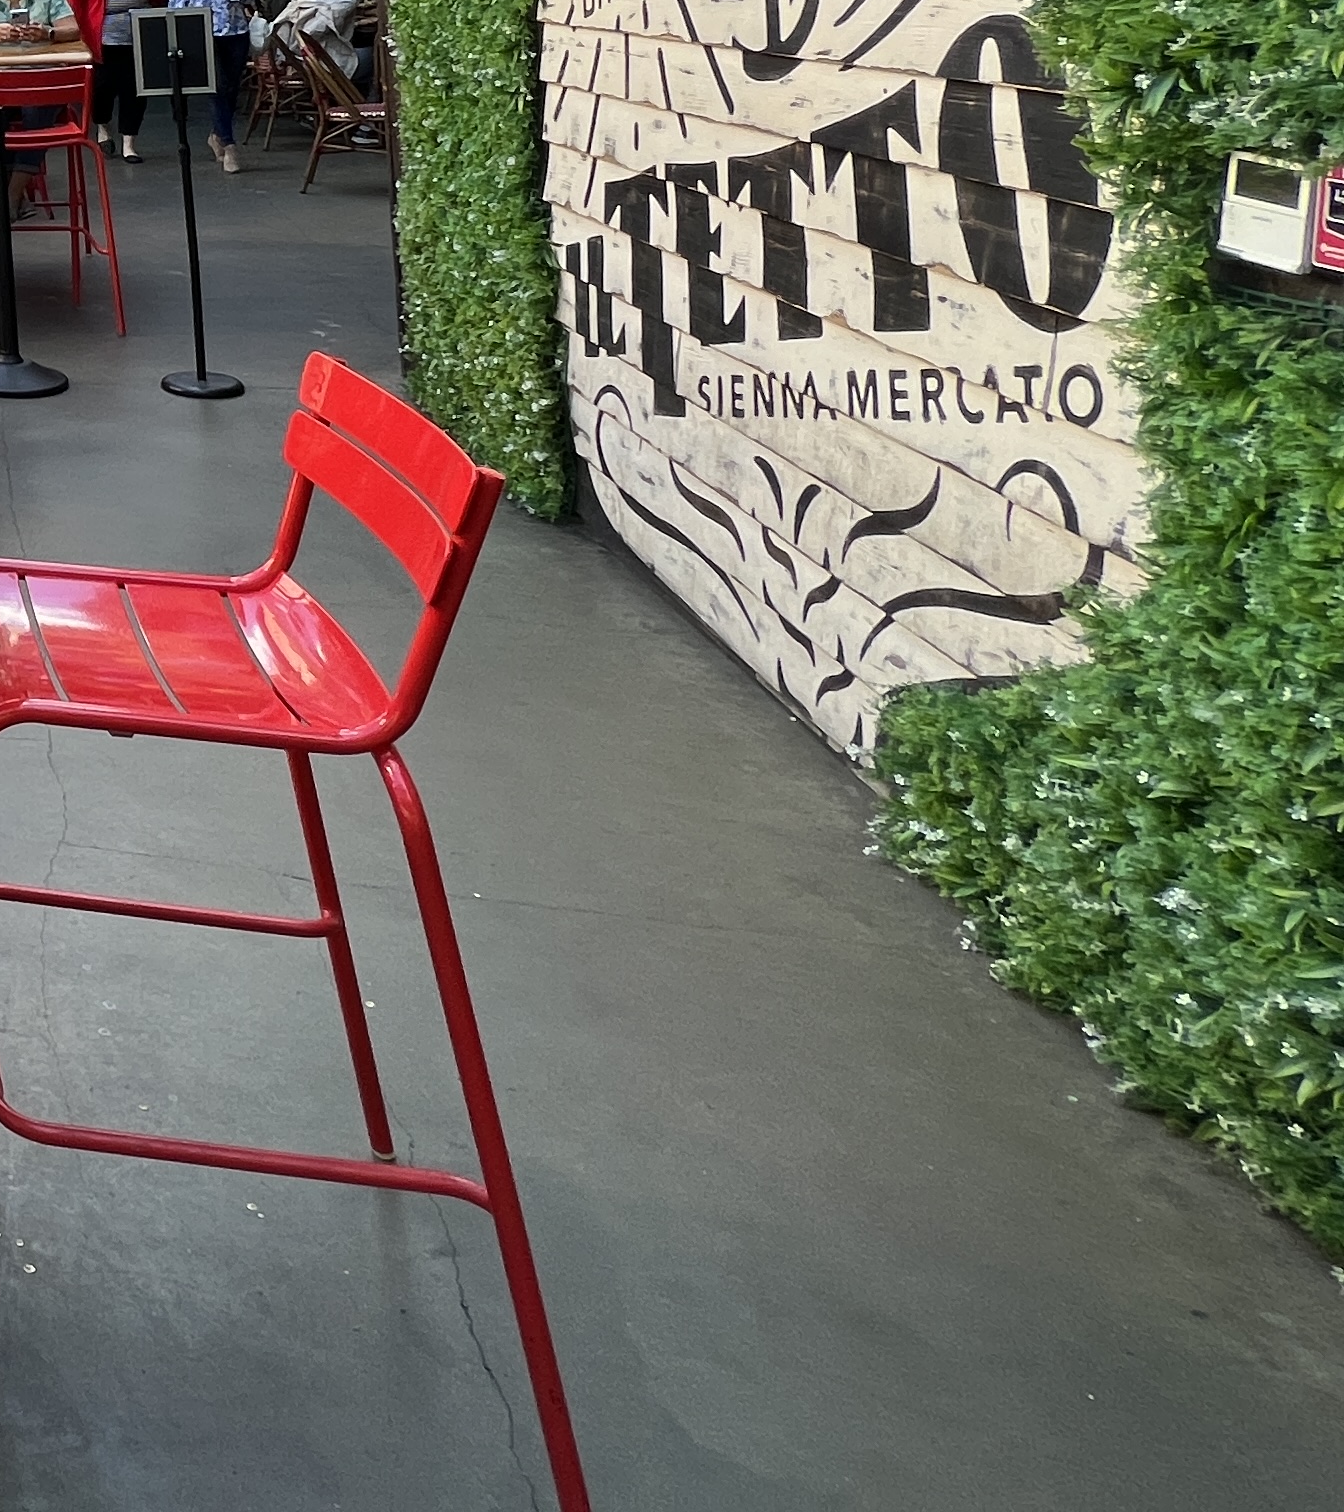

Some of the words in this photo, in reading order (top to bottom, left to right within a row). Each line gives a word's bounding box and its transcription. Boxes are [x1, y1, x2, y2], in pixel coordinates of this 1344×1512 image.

[565, 234, 626, 357] IL
[604, 14, 1114, 418] TETTO
[697, 372, 838, 420] SIENNA
[845, 363, 1104, 425] MERCATO
